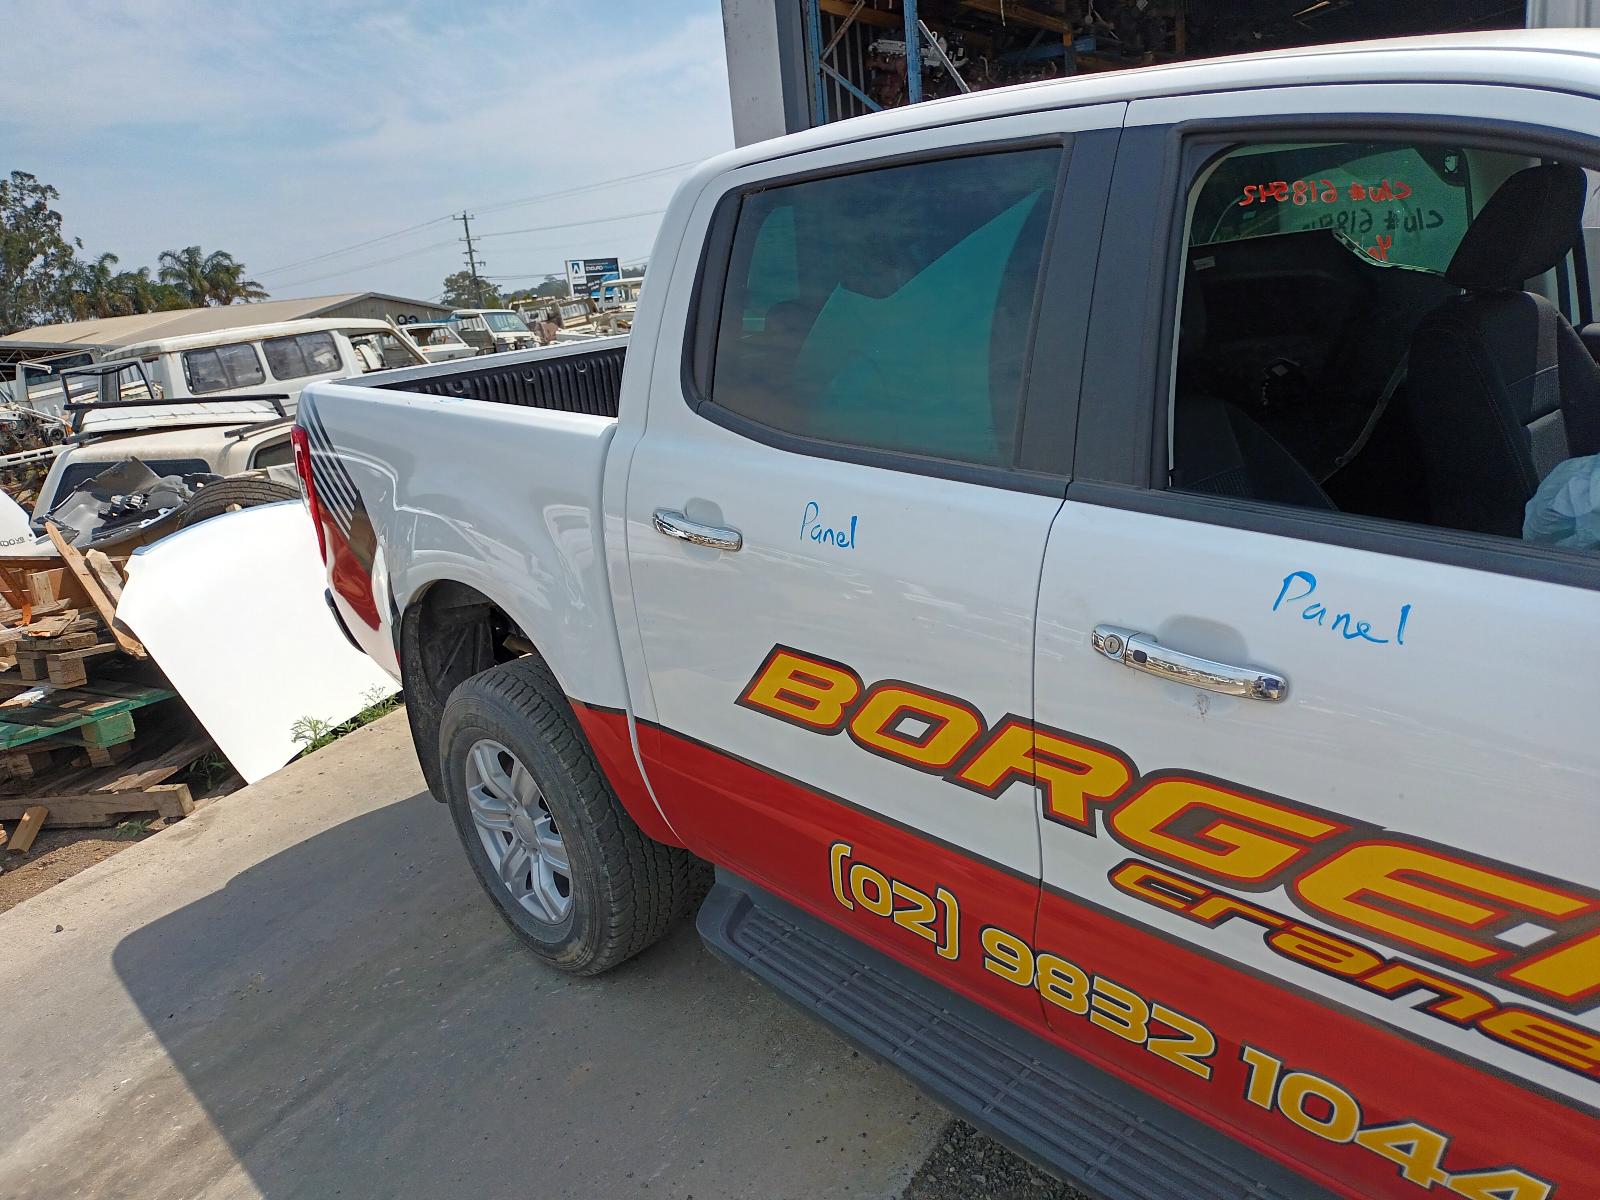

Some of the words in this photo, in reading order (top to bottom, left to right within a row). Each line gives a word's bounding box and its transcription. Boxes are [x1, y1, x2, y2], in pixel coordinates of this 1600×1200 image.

[800, 501, 858, 549] Panel
[1272, 570, 1411, 645] Panel
[735, 643, 1600, 1016] BORGE
[829, 841, 960, 961] (02)
[981, 924, 1216, 1081] 9832
